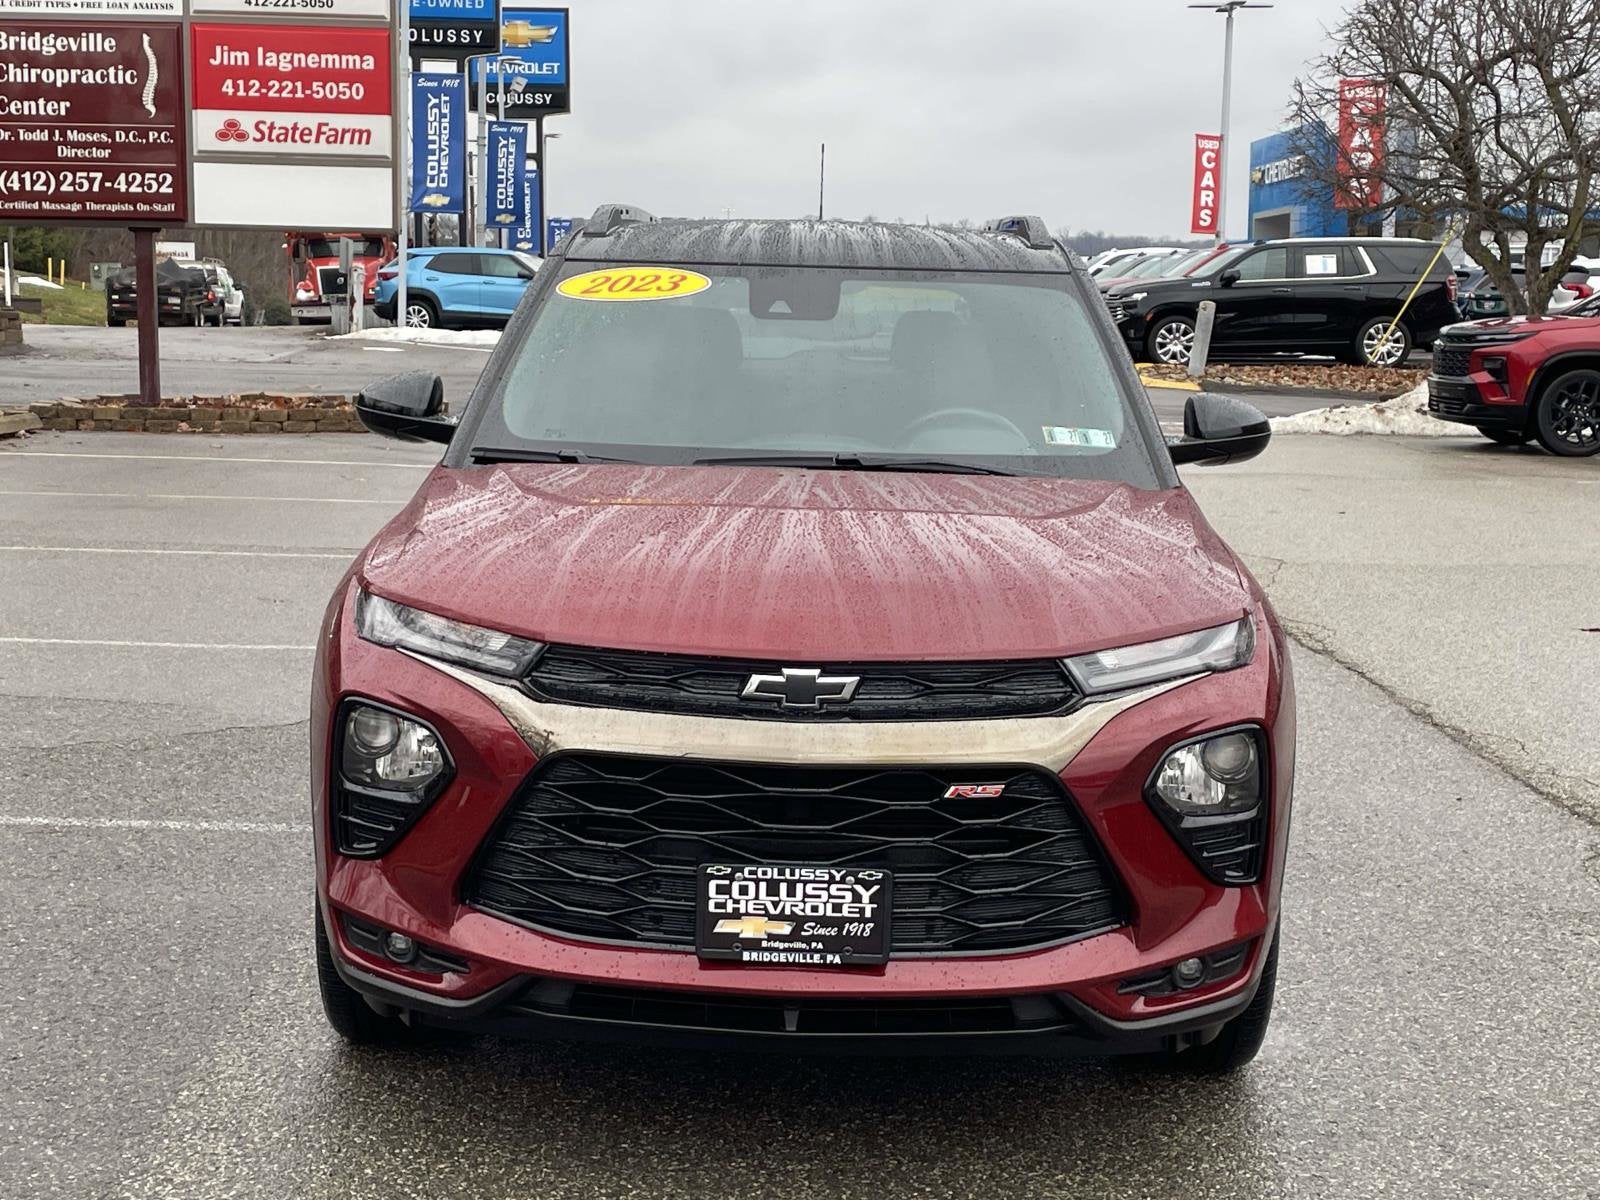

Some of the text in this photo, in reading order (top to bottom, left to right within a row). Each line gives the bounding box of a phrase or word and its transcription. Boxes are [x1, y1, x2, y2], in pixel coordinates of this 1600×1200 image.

[9, 0, 41, 8] CREDIT
[80, 1, 103, 9] FREE
[107, 2, 129, 10] LOAN
[133, 2, 174, 11] ANALYSIS
[244, 0, 334, 8] 412-221-5050
[408, 0, 485, 9] E-OWNED
[0, 31, 117, 56] Bridgeville
[400, 28, 483, 43] OLUSSY
[209, 45, 375, 72] Jim Iagnemma
[0, 63, 138, 88] Chiropractic
[477, 61, 561, 74] HVROLET
[221, 78, 365, 100] 412-221-5050
[442, 79, 460, 88] 1918
[0, 95, 71, 117] Center
[0, 129, 174, 145] Dr. Todd J. Moses, D.C., P.C.
[426, 92, 440, 188] COLUSSY
[438, 92, 451, 188] CHEVROLET
[1197, 138, 1220, 150] USED
[57, 145, 112, 159] Director
[496, 135, 508, 210] COLUSSY
[506, 136, 517, 210] CHEVROLET
[0, 170, 174, 195] (412) 257-4252
[1198, 151, 1217, 228] CARS
[0, 201, 175, 212] Certified Massage Therapists On-Staff
[580, 275, 687, 294] 2023
[943, 784, 1006, 799] RS
[743, 867, 846, 881] COLUSSY
[708, 880, 880, 904] COLUSSY
[708, 899, 877, 918] CHEVROLET
[801, 922, 874, 937] Since 1918
[761, 940, 824, 950] Bridgeville, PA
[826, 954, 842, 965] PA
